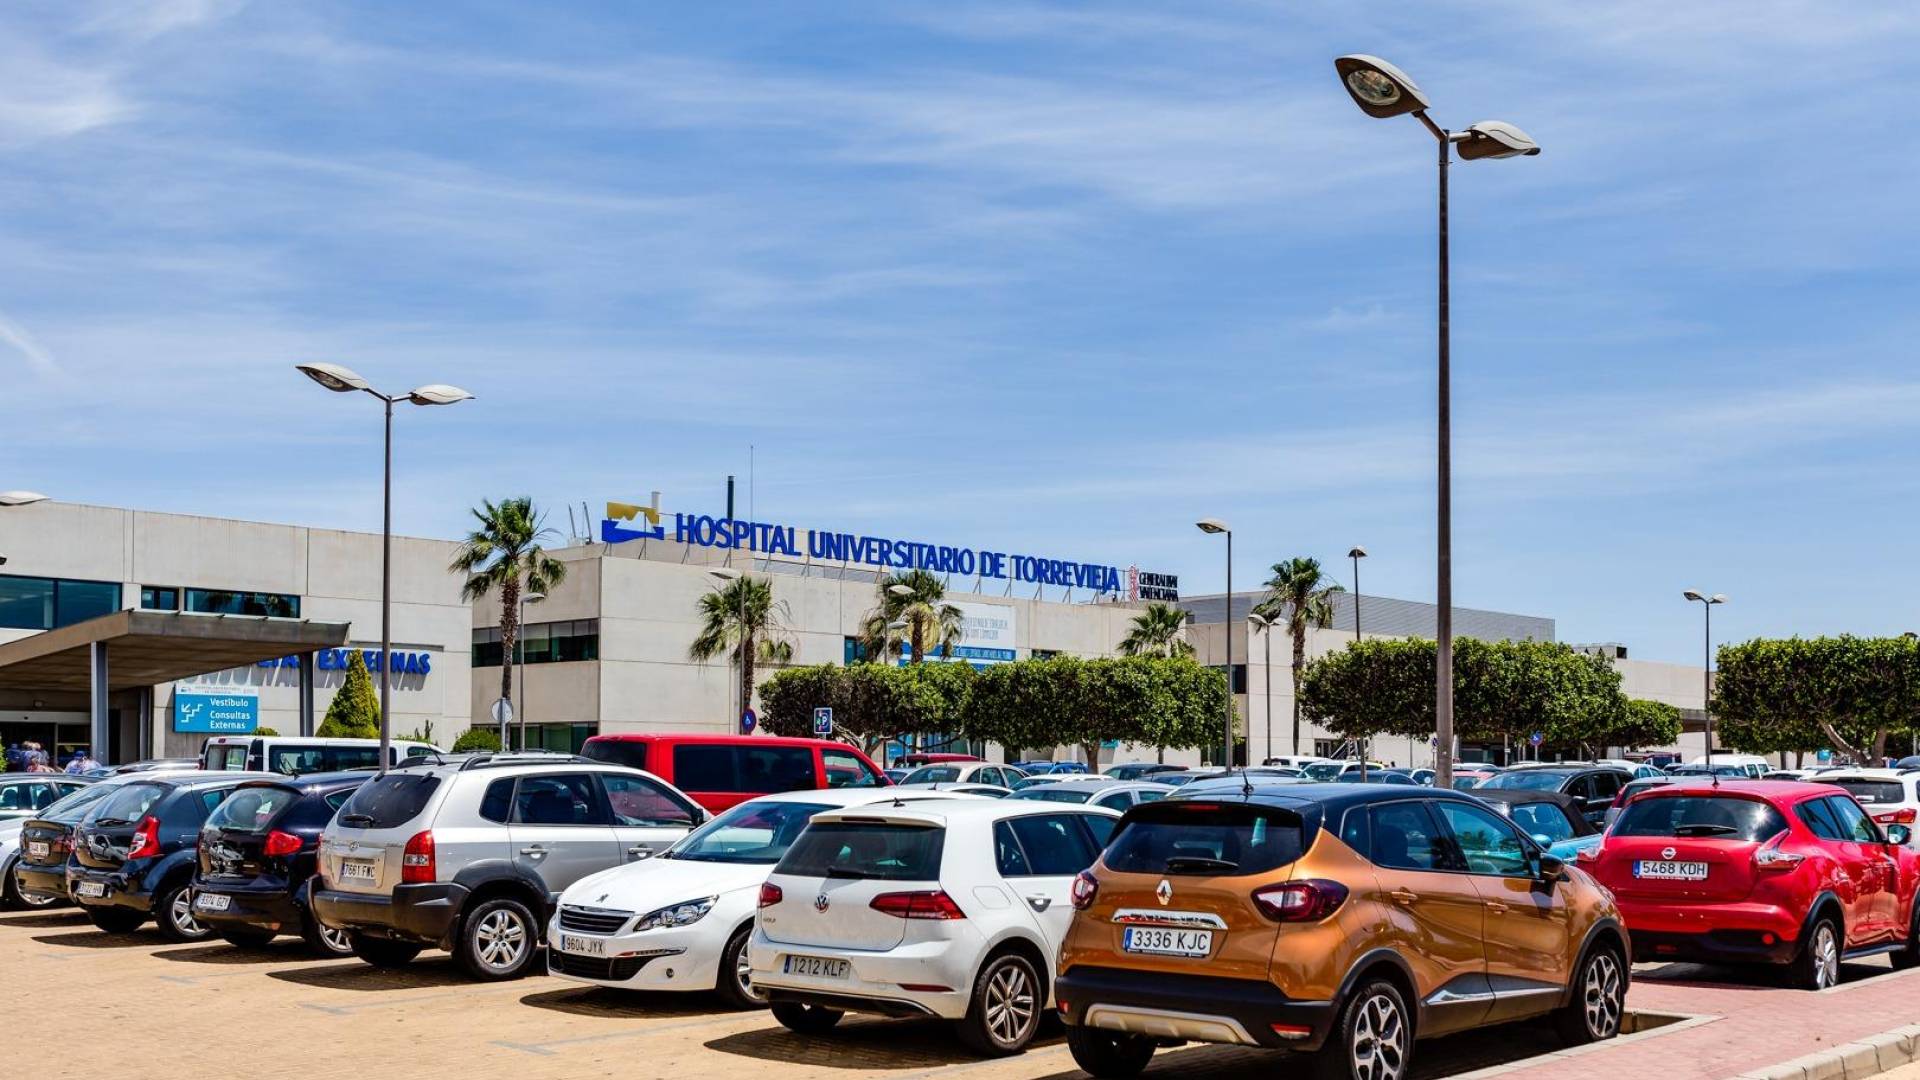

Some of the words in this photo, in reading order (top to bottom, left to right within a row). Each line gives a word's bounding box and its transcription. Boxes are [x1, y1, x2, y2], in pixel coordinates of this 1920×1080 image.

[676, 513, 801, 556] HOSPITAL
[808, 530, 975, 576] UNIVERSITARIO
[980, 551, 1006, 579] DE
[1011, 554, 1120, 593] TORREVIEJA
[210, 698, 249, 707] Vestibulo
[210, 710, 251, 719] Consultas
[210, 720, 246, 729] Externas
[1643, 862, 1676, 874] 5468
[1680, 863, 1705, 875] KDH
[567, 937, 584, 951] 9604
[587, 940, 603, 954] JYX
[1134, 930, 1172, 949] 3336
[1176, 932, 1208, 951] KJC
[793, 957, 821, 975] 1212
[823, 960, 847, 977] KLF
